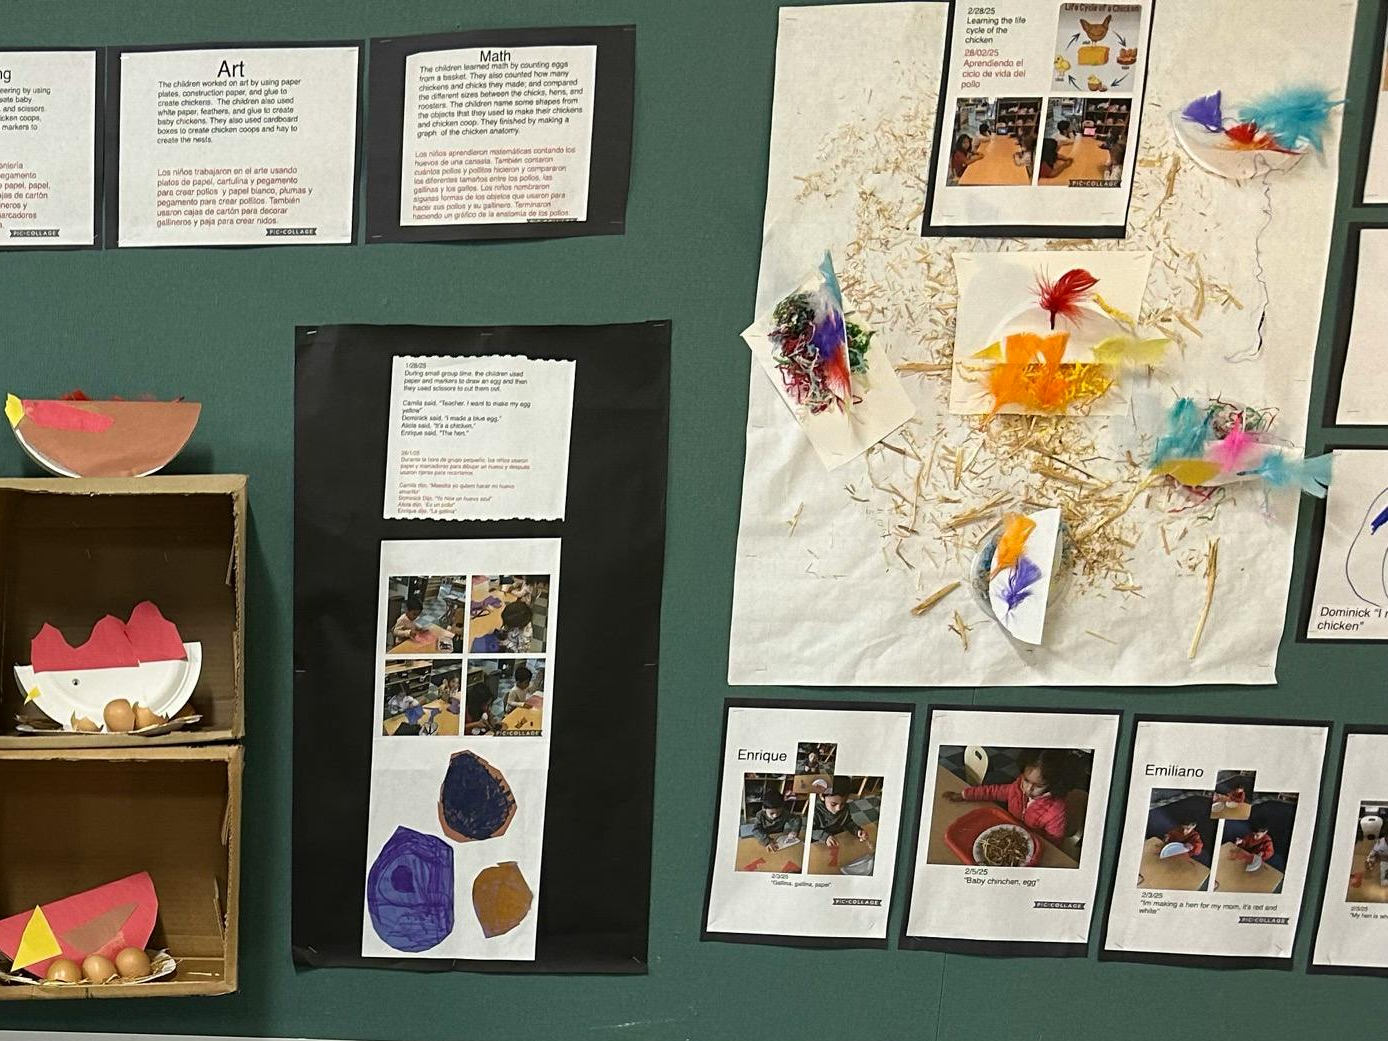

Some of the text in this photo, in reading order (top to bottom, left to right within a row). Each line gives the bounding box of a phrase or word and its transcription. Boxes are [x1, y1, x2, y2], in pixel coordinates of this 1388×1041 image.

[967, 17, 998, 25] Learning
[966, 27, 985, 35] cycle
[480, 50, 510, 62] Math
[963, 59, 1013, 67] Aprendiendo
[218, 61, 244, 77] Art
[250, 79, 259, 87] by
[961, 80, 980, 89] pollo
[1320, 607, 1370, 617] Dominick
[1317, 621, 1364, 630] chicken"
[738, 749, 786, 762] Enrique
[1145, 764, 1203, 777] Emiliano
